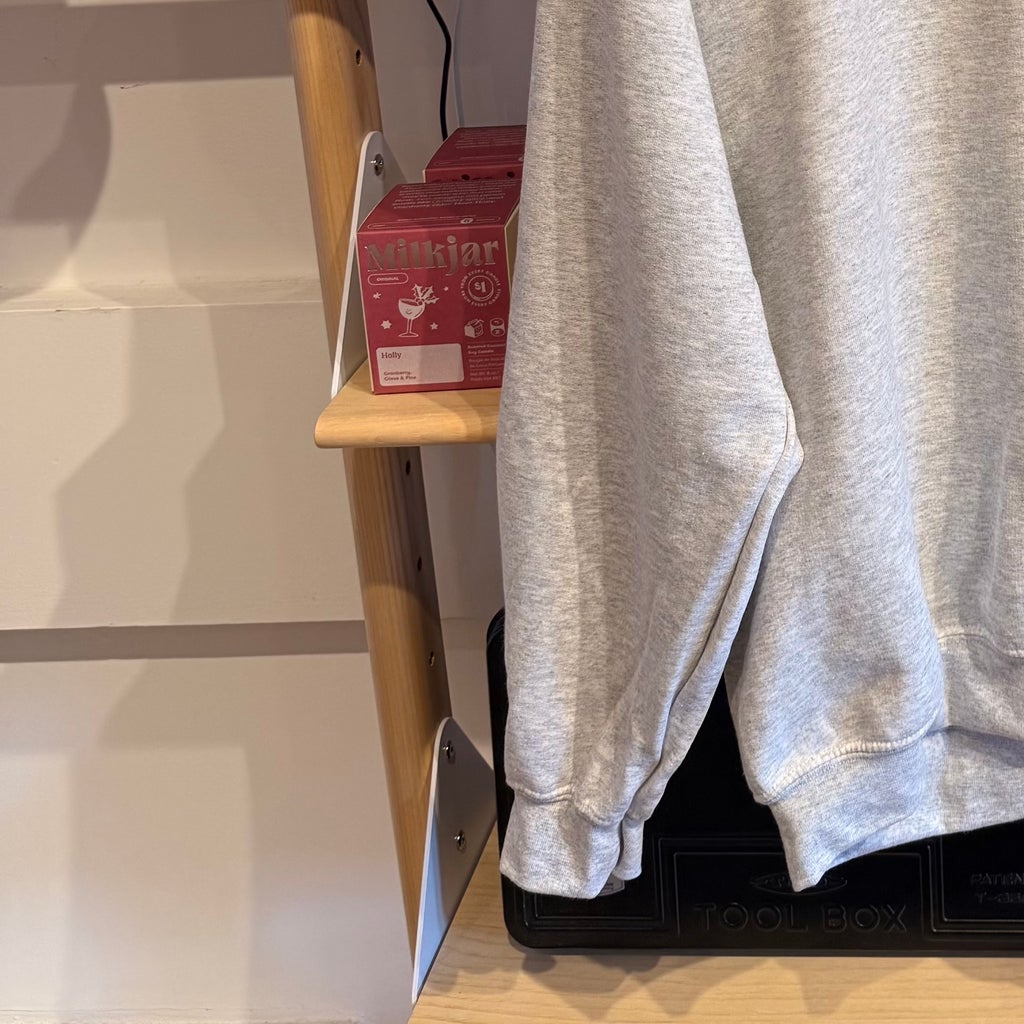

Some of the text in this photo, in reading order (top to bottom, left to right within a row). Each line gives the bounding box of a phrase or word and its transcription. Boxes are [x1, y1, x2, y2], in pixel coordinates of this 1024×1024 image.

[364, 235, 499, 276] Milkjar
[474, 281, 487, 293] $1
[381, 352, 402, 360] Holly
[693, 902, 907, 933] TOOL BOX
